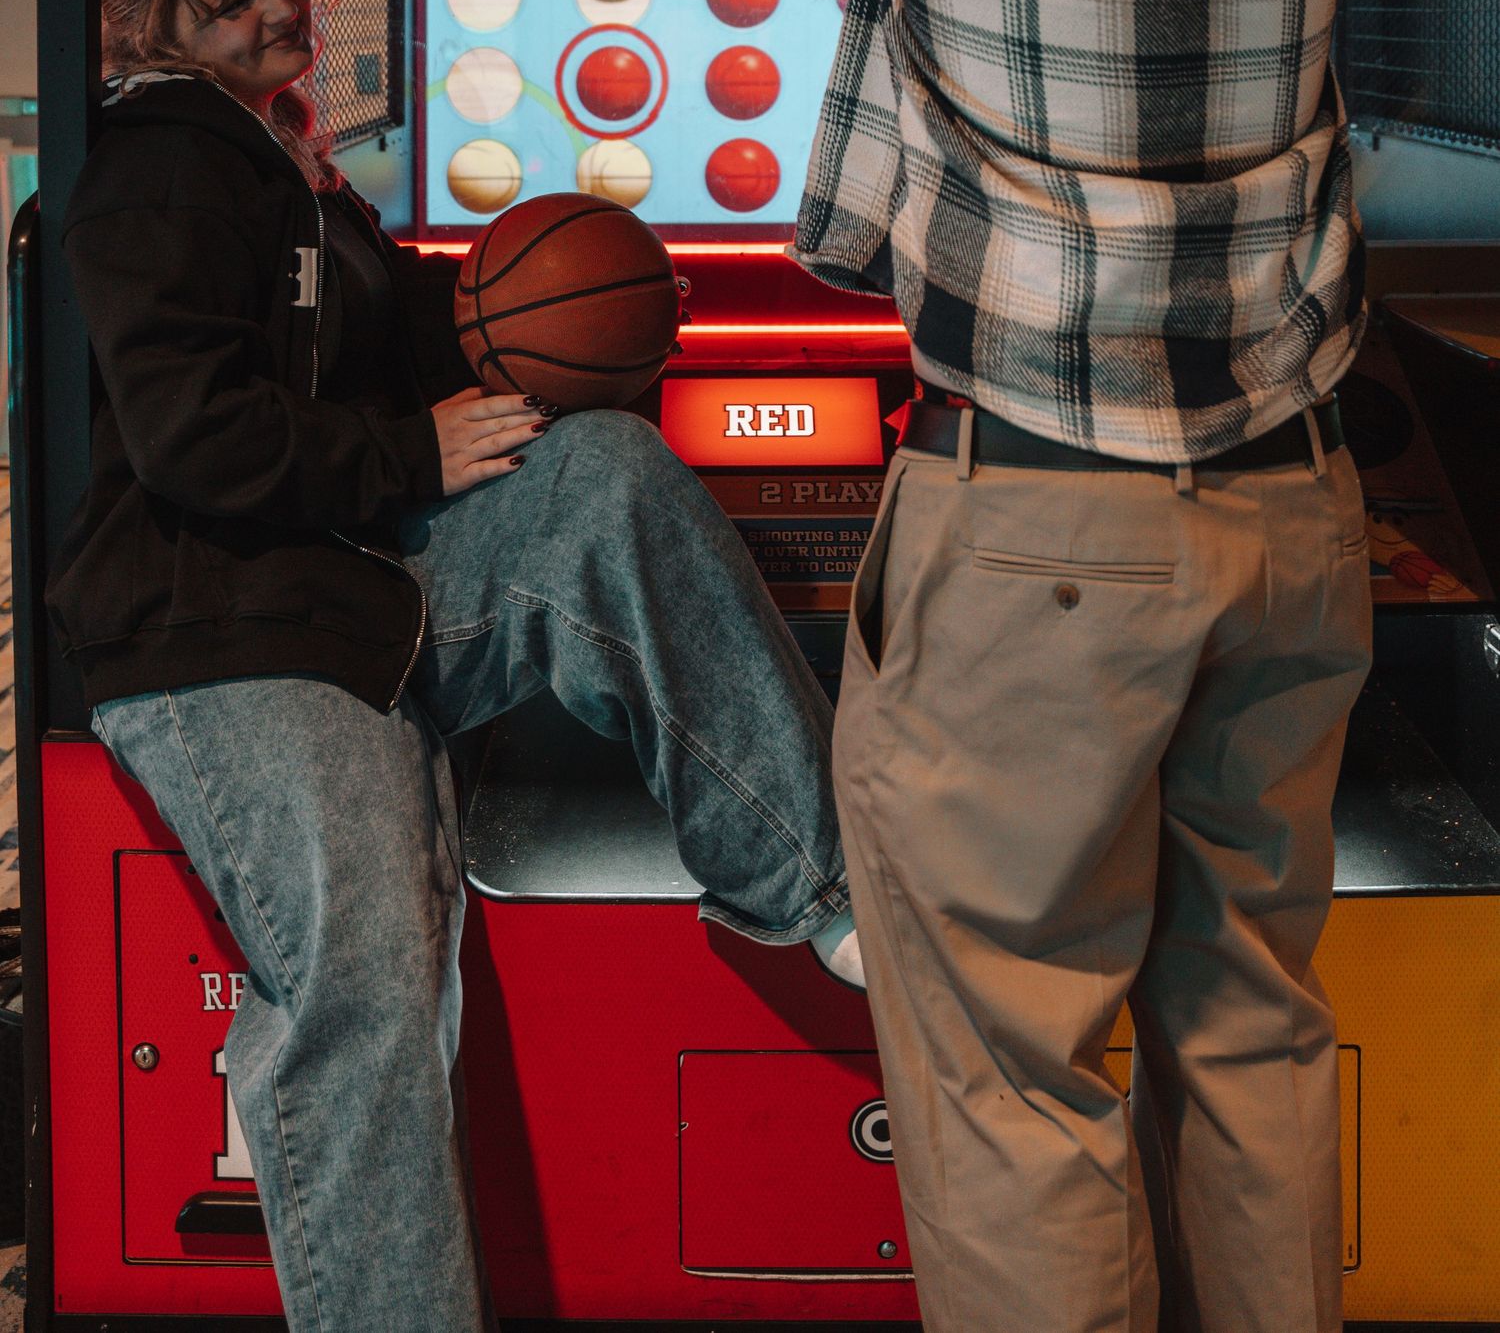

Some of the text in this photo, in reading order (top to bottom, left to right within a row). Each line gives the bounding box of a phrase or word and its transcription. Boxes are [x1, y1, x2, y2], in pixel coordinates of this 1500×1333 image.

[724, 403, 816, 438] RED
[760, 481, 883, 504] 2 PLAY
[747, 530, 834, 543] SHOOTING
[764, 545, 809, 558] OVER
[796, 560, 819, 573] TO
